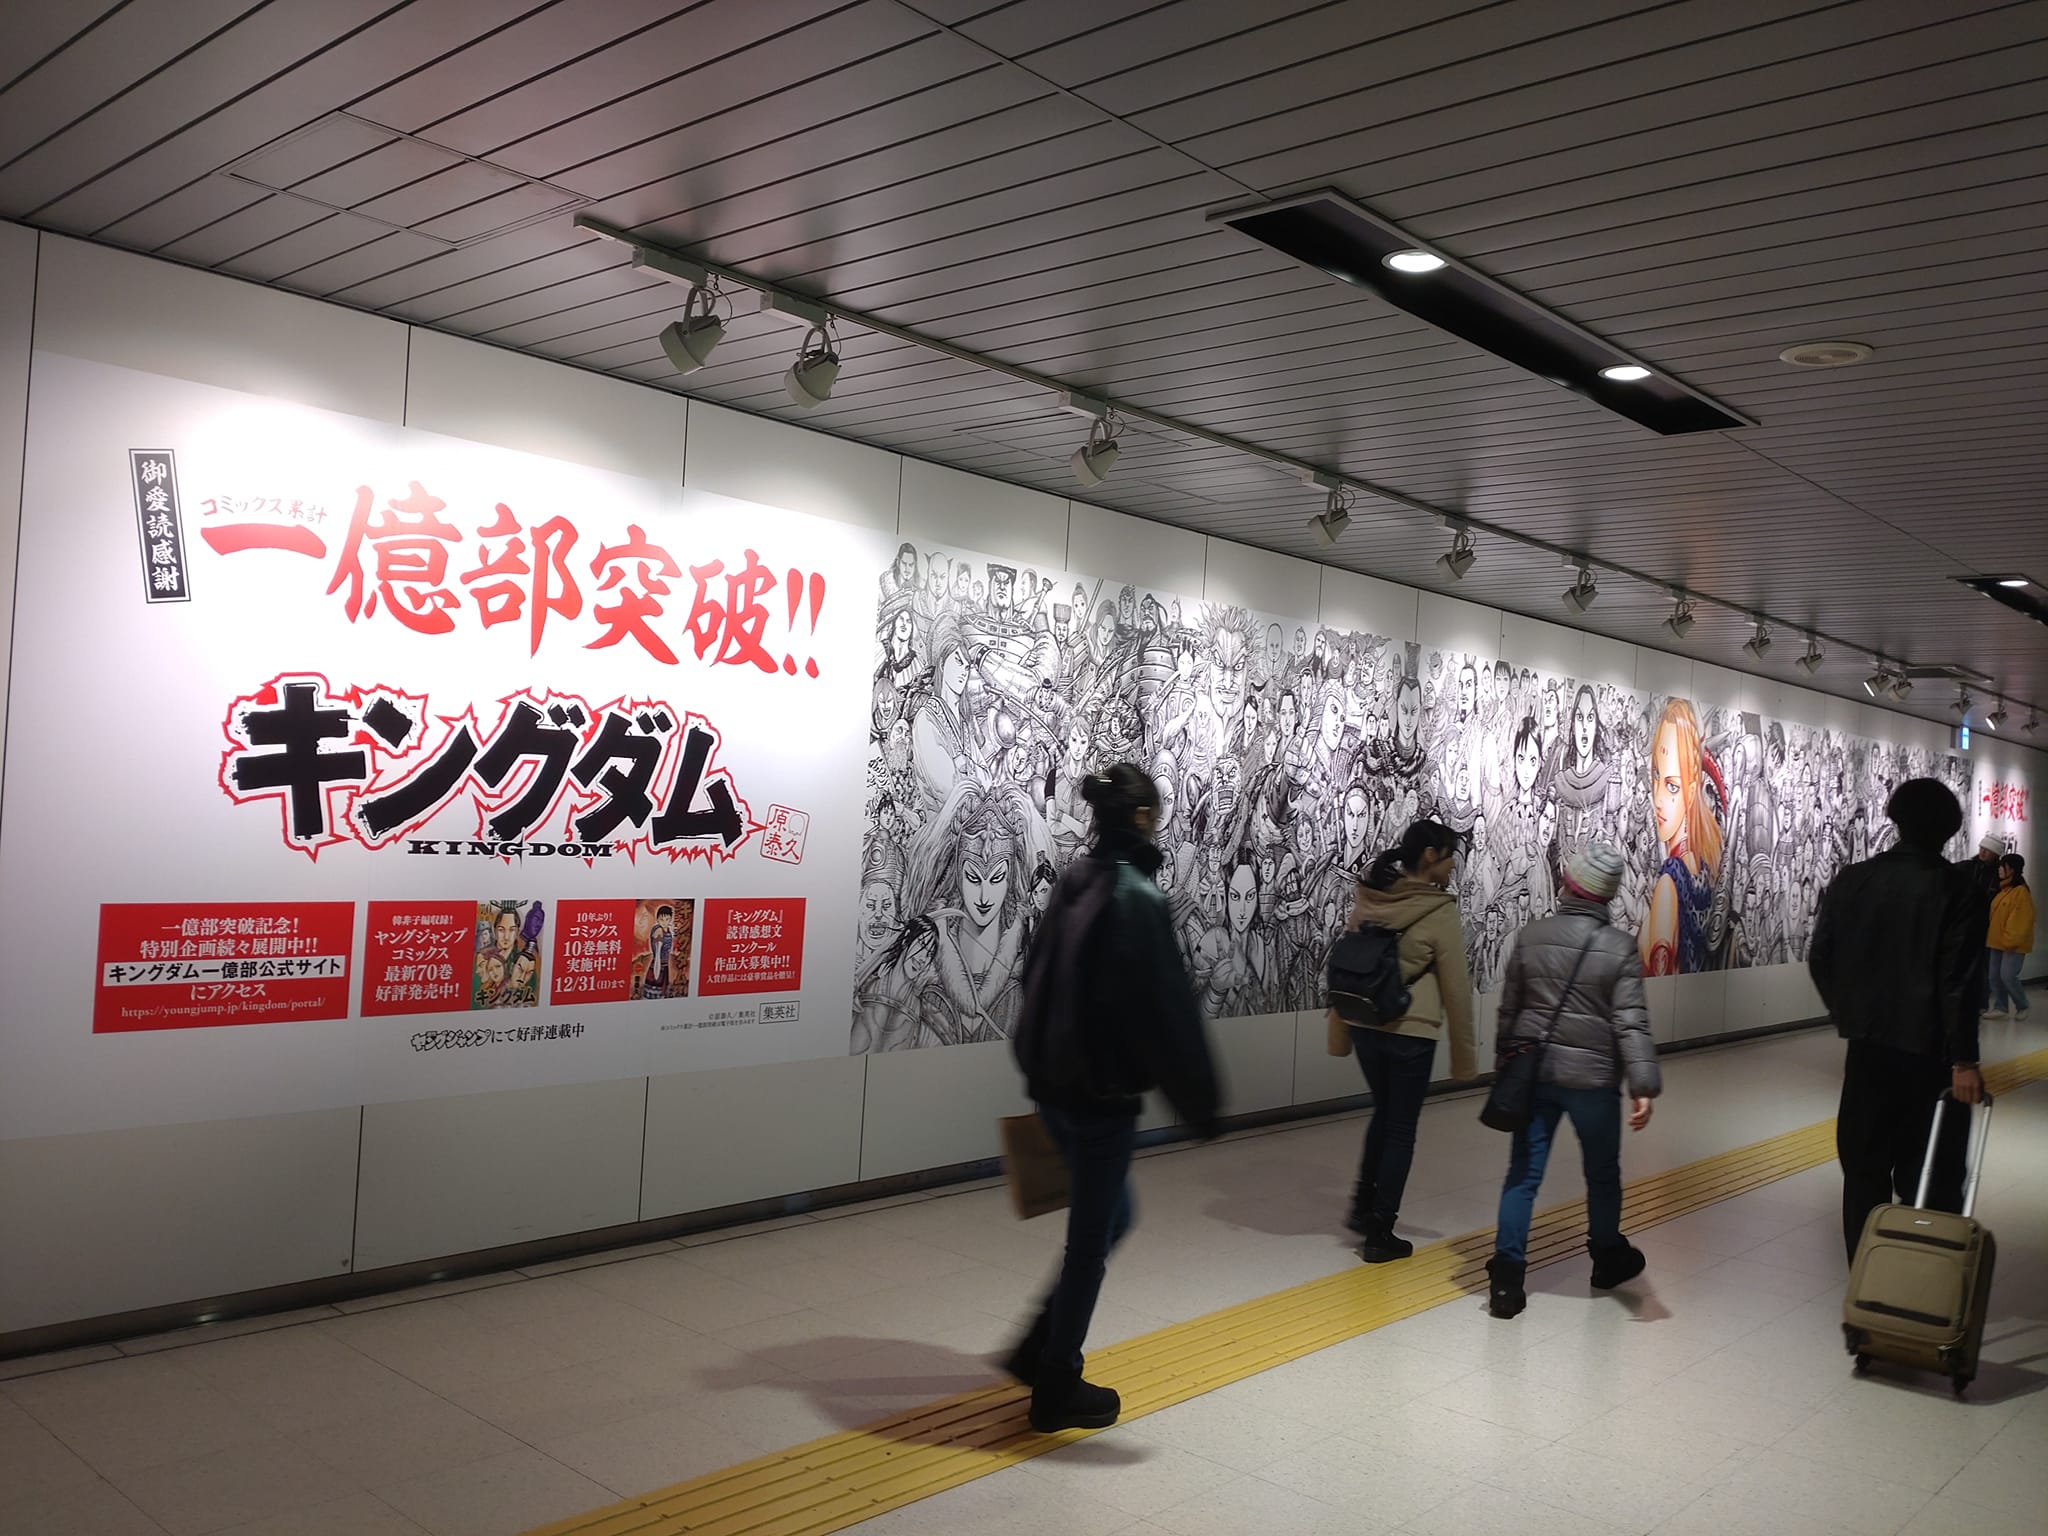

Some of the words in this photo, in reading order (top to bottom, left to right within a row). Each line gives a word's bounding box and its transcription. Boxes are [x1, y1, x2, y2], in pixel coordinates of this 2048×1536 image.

[200, 495, 328, 524] コミックス累計
[141, 459, 180, 592] 御愛読感謝
[200, 480, 827, 680] 一億部突破!!
[230, 682, 744, 846] キングダム
[407, 839, 612, 858] KINGDOM
[161, 917, 299, 937] 一億部突破記念!
[374, 927, 468, 946] ヤングジャンプ
[569, 924, 618, 938] コミックス
[726, 924, 783, 940] 読書感想文
[140, 937, 318, 959] 特別企画続々展開中!!
[391, 946, 449, 961] コミックス
[563, 940, 622, 957] 10巻無料
[730, 941, 776, 954] コンクール
[108, 958, 341, 983] キングダム一億部公式サイト
[384, 964, 453, 982] 最新70巻
[567, 957, 617, 973] 実施中!!
[714, 955, 790, 972] 作品大募集中!!
[190, 983, 267, 1000] にアクセス
[375, 983, 460, 1002] 好評発売中!
[121, 997, 326, 1018] https://youngjump.jp/kingdom/portal/
[763, 1004, 796, 1020] 集英社
